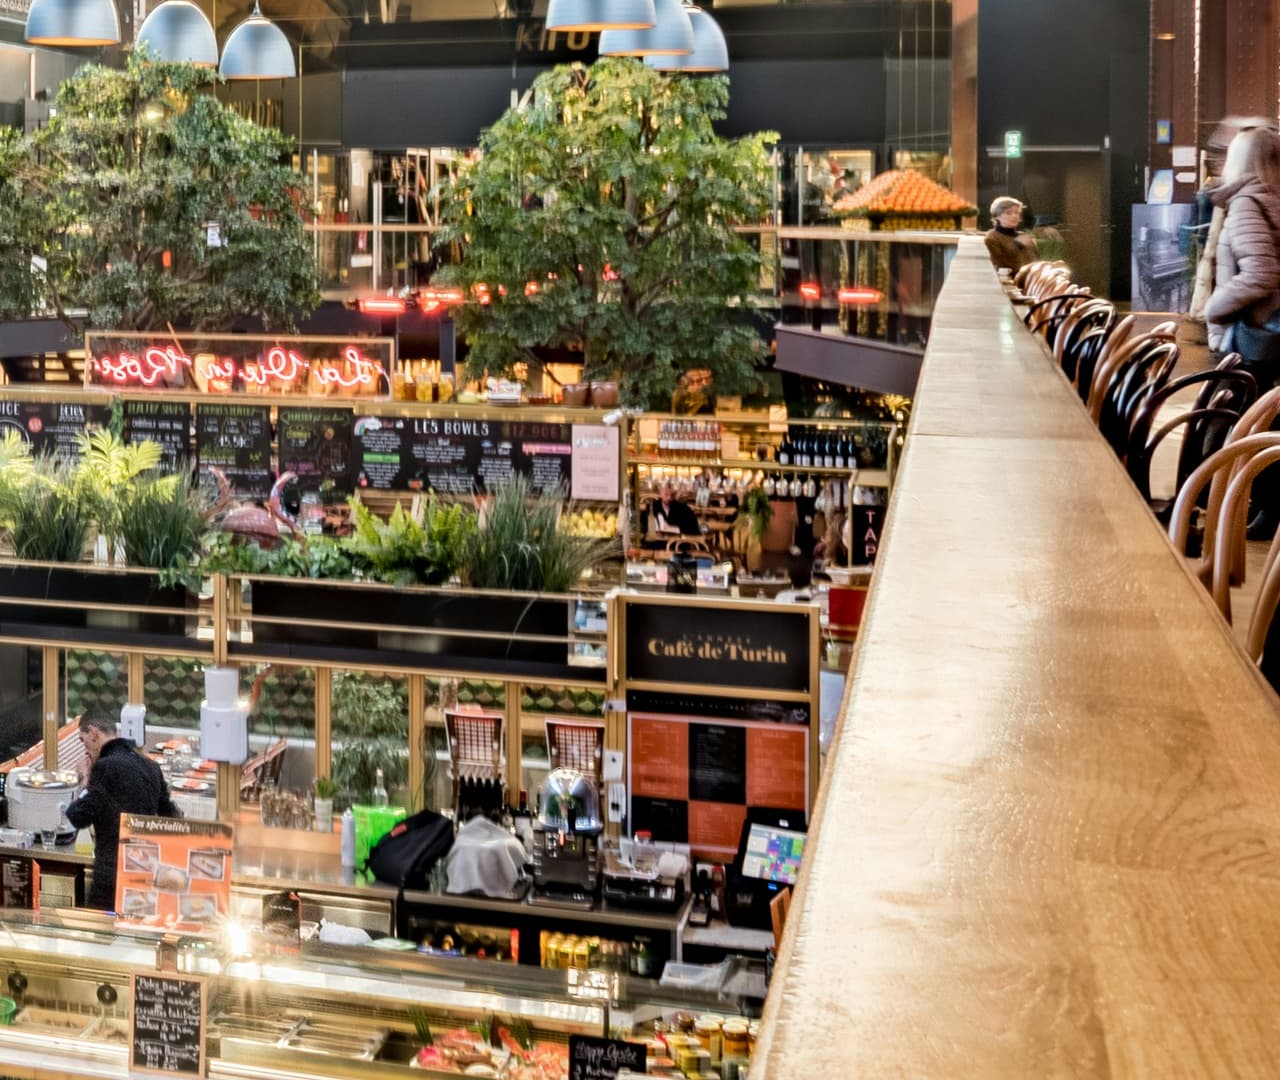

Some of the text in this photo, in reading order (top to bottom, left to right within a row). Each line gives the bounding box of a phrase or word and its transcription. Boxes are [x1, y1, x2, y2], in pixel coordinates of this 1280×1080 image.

[414, 419, 438, 435] LES
[444, 421, 490, 437] BOWLS
[865, 510, 877, 560] TAP
[647, 637, 788, 664] Café de Turin
[127, 818, 191, 834] Nos spécialités
